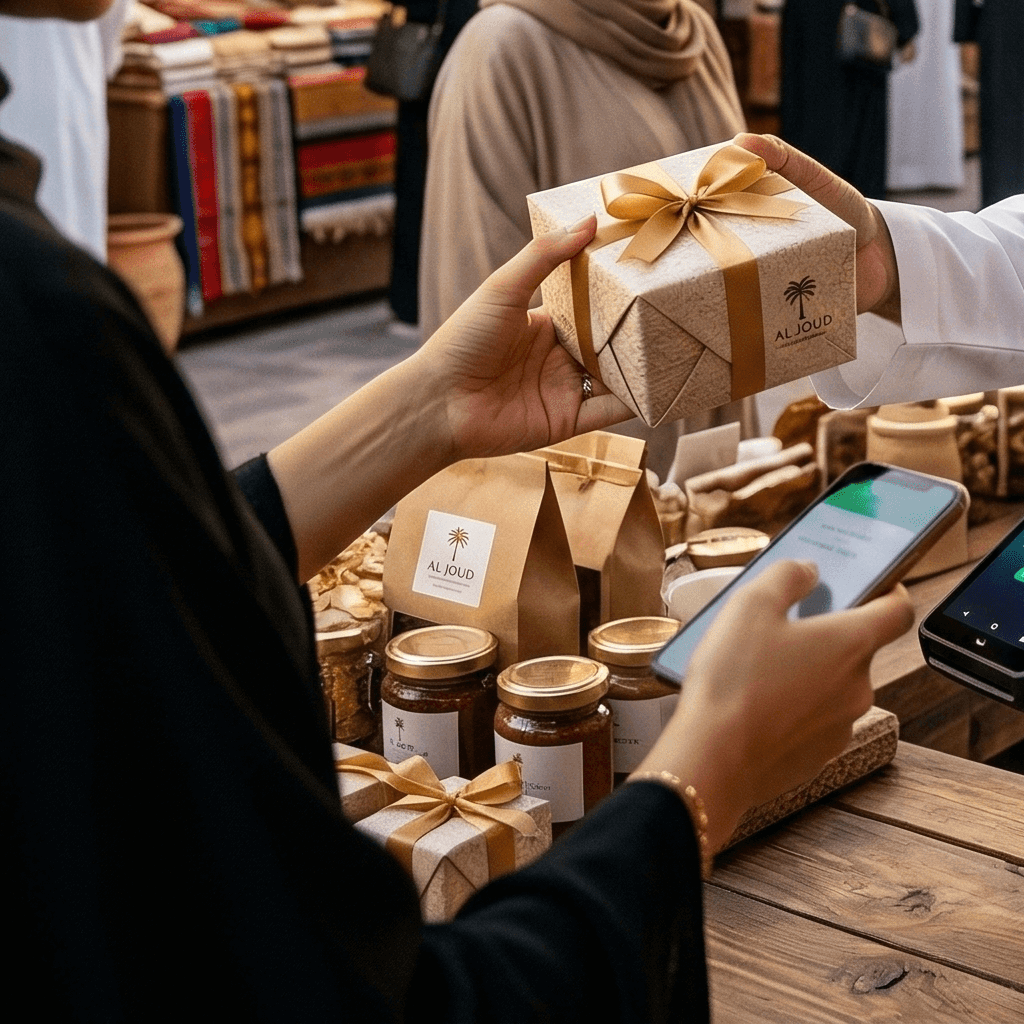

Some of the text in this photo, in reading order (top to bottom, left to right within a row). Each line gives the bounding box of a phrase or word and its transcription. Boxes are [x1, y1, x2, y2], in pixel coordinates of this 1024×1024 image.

[774, 327, 792, 343] AL
[793, 314, 834, 337] JOUD
[427, 560, 475, 580] AL JOUD
